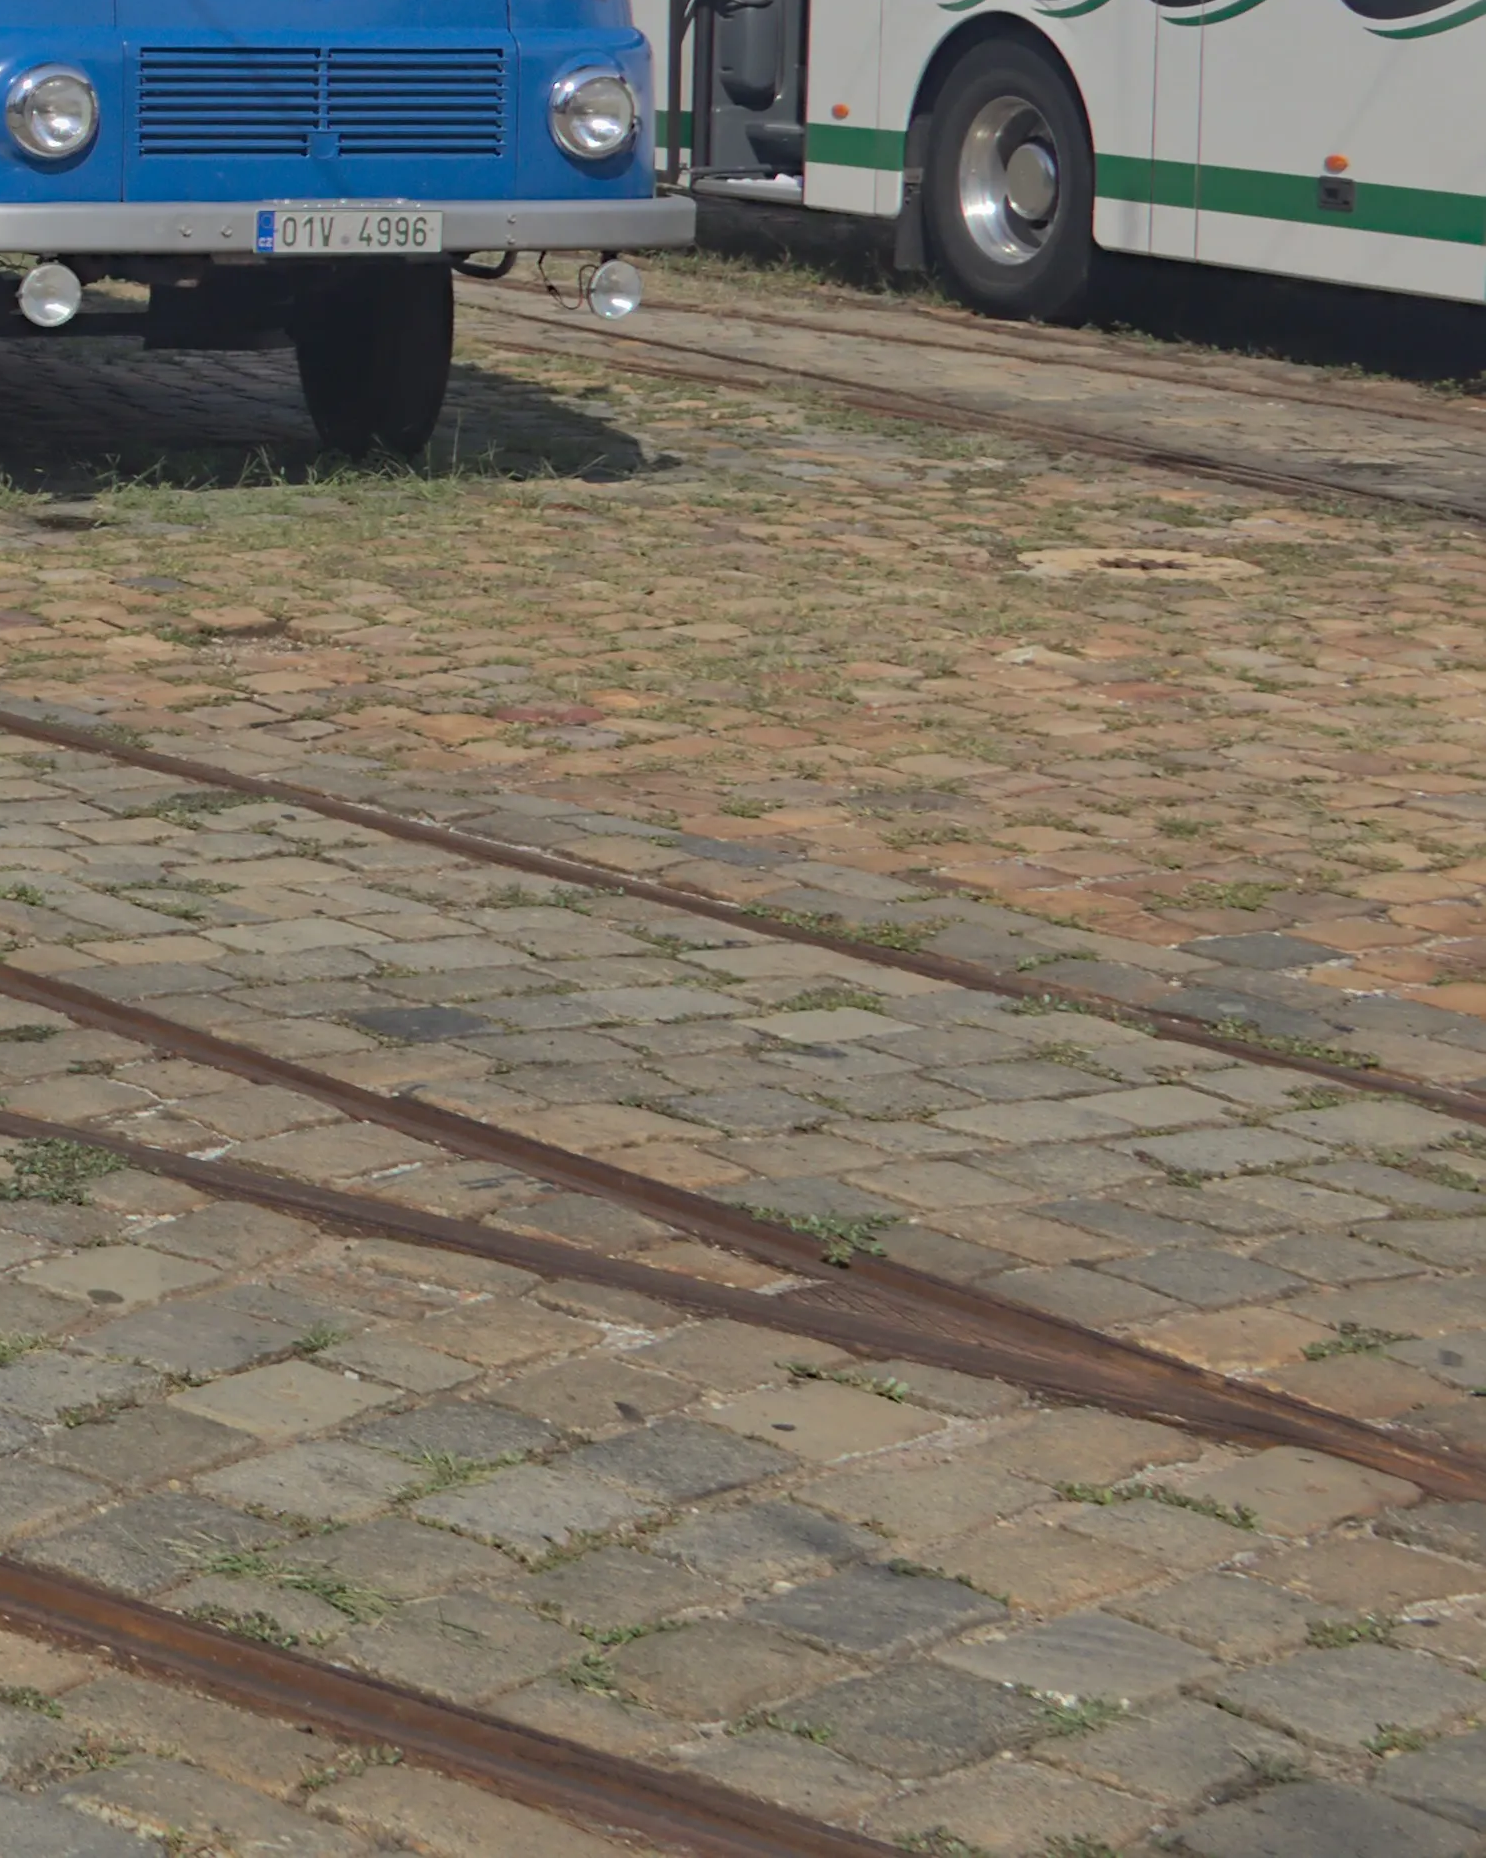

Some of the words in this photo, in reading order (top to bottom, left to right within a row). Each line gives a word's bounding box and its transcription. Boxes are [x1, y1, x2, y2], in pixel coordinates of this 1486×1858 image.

[282, 216, 334, 247] 01V
[358, 216, 428, 247] 4996
[258, 238, 273, 247] CZ
